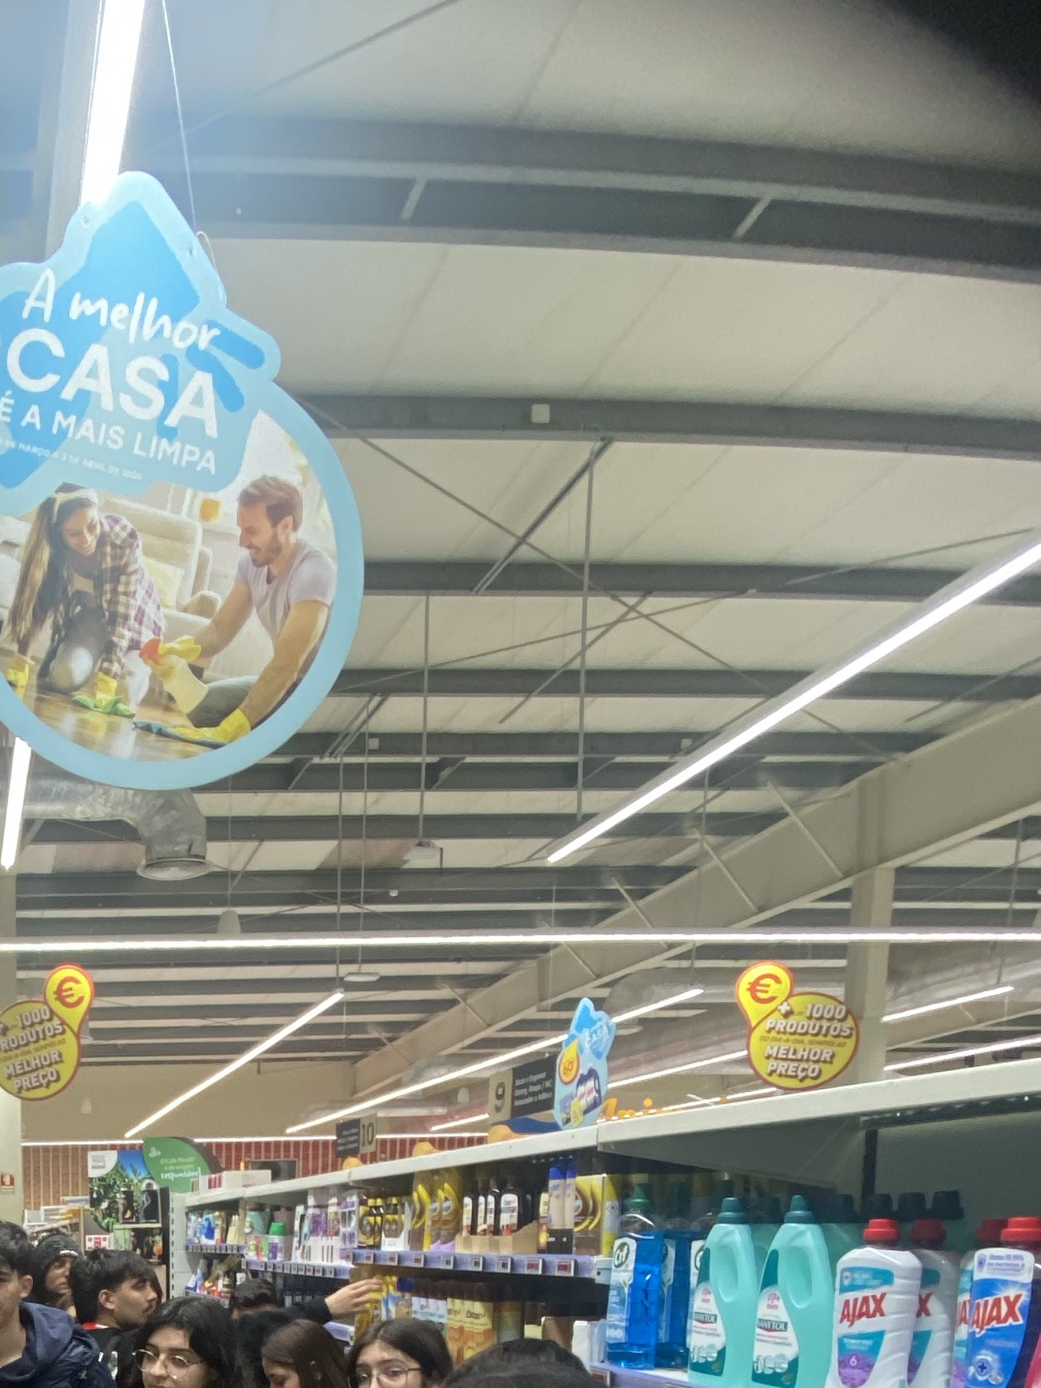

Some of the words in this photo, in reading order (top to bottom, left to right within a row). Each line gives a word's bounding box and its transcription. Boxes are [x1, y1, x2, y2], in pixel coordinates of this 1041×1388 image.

[22, 268, 56, 323] A
[69, 291, 221, 351] melhor
[6, 328, 218, 438] CASA
[20, 404, 42, 430] A
[52, 411, 126, 450] MAIS
[133, 431, 216, 475] LIMPA
[17, 1005, 51, 1029] 1000
[806, 1004, 848, 1022] 1000
[765, 1019, 853, 1039] PRODUTOS
[4, 1049, 63, 1079] MELHOR
[765, 1045, 835, 1064] MELHOR
[14, 1067, 60, 1093] PREÇO
[767, 1061, 822, 1082] PREÇO
[495, 1082, 505, 1113] 9
[361, 1122, 375, 1147] 10
[839, 1292, 887, 1328] AJAX
[971, 1293, 1024, 1334] AJAX
